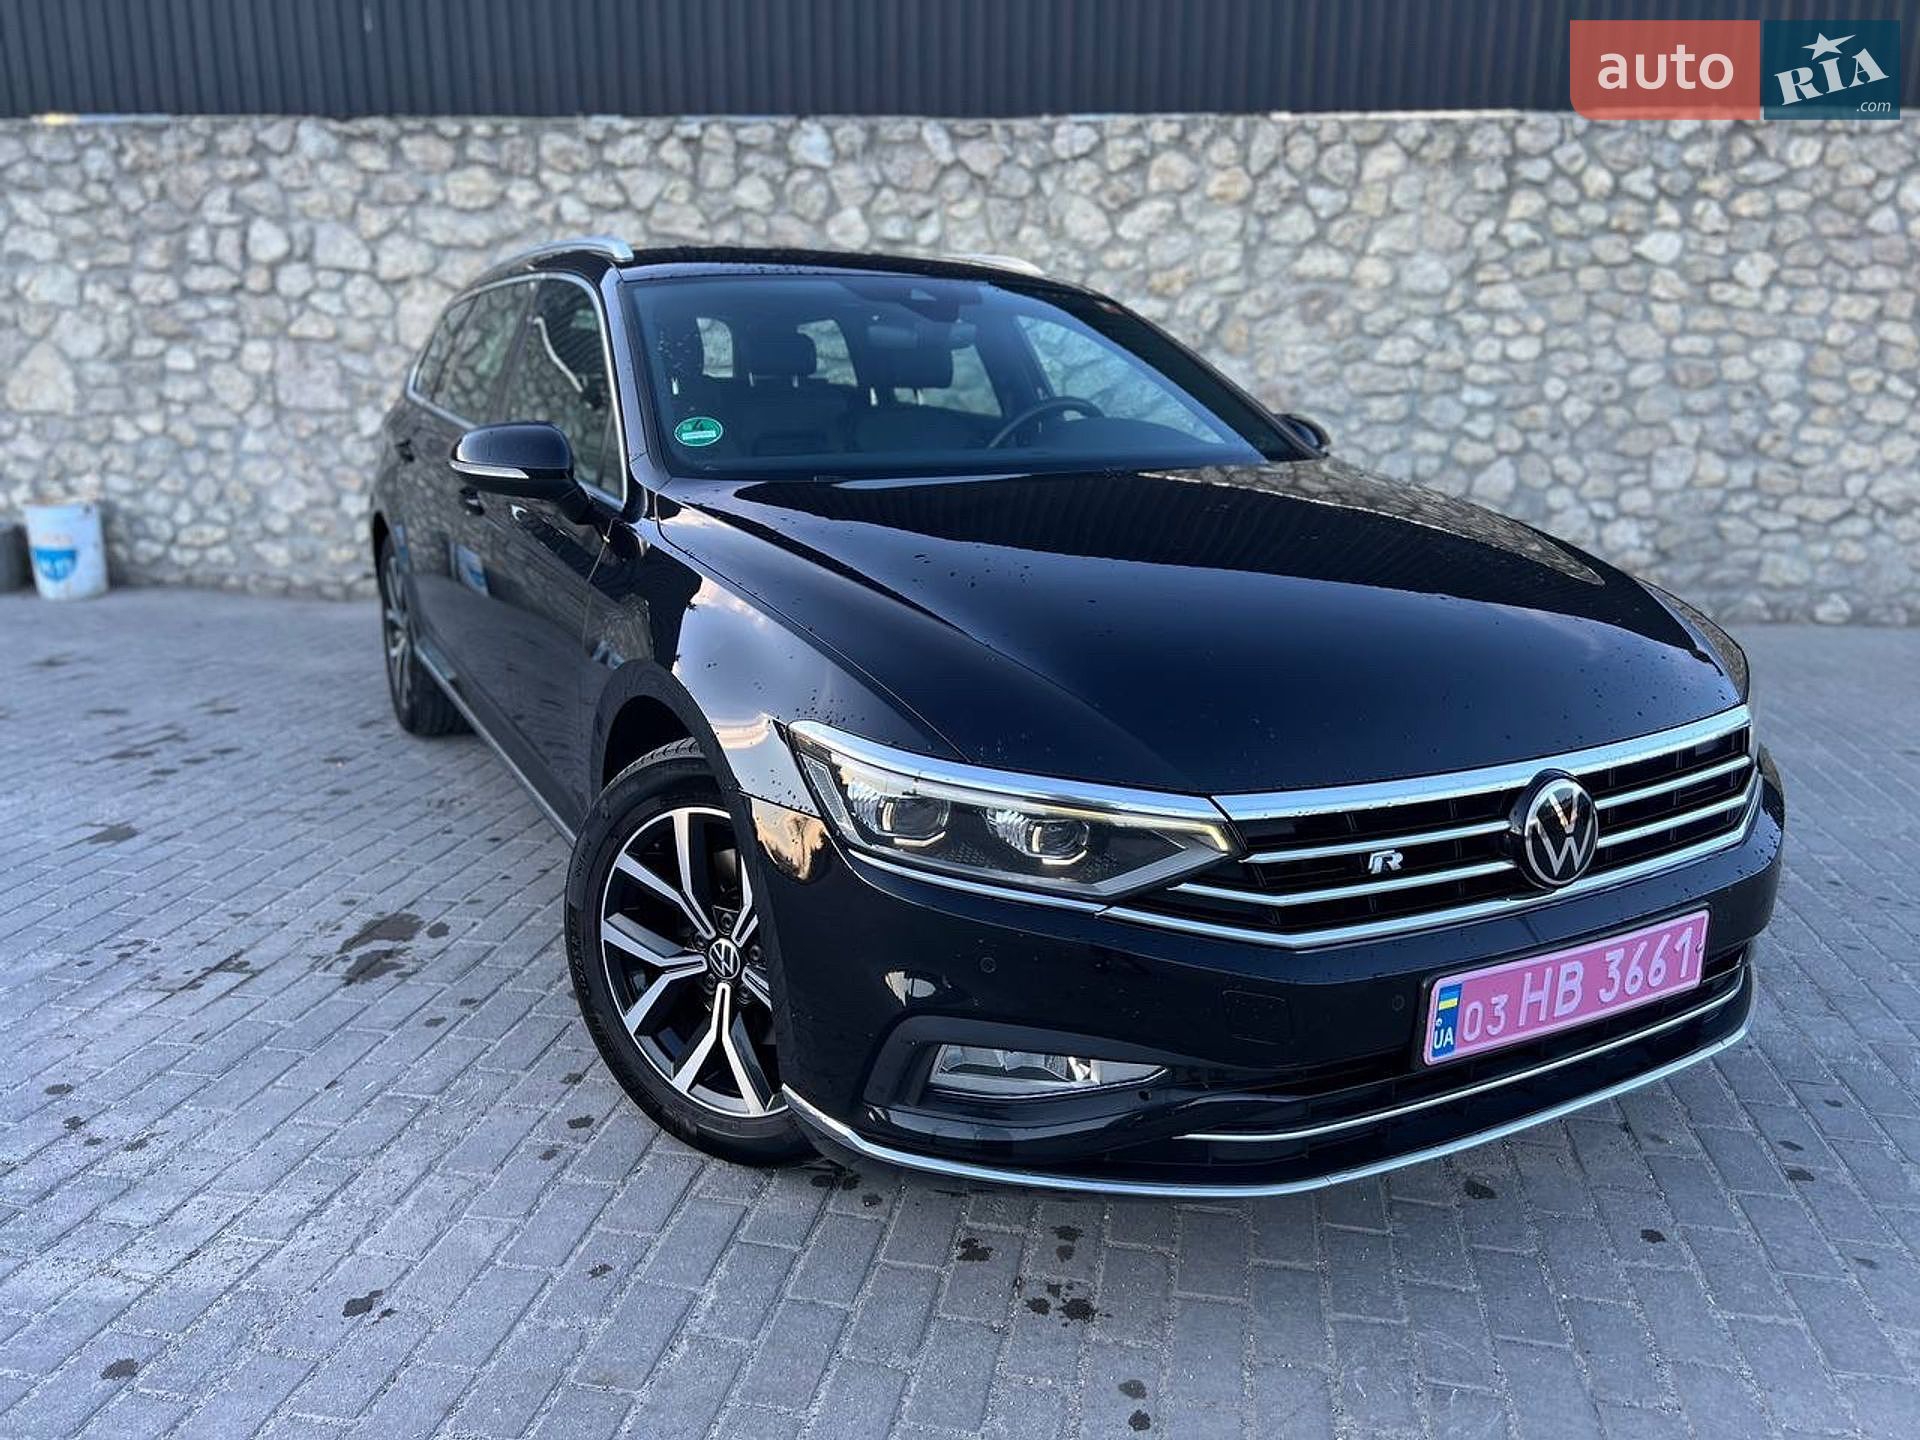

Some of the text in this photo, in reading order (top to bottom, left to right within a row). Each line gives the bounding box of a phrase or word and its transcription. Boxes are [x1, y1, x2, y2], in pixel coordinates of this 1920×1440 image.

[1462, 926, 1694, 1042] 03 HB 3661
[1433, 1026, 1454, 1049] UA
